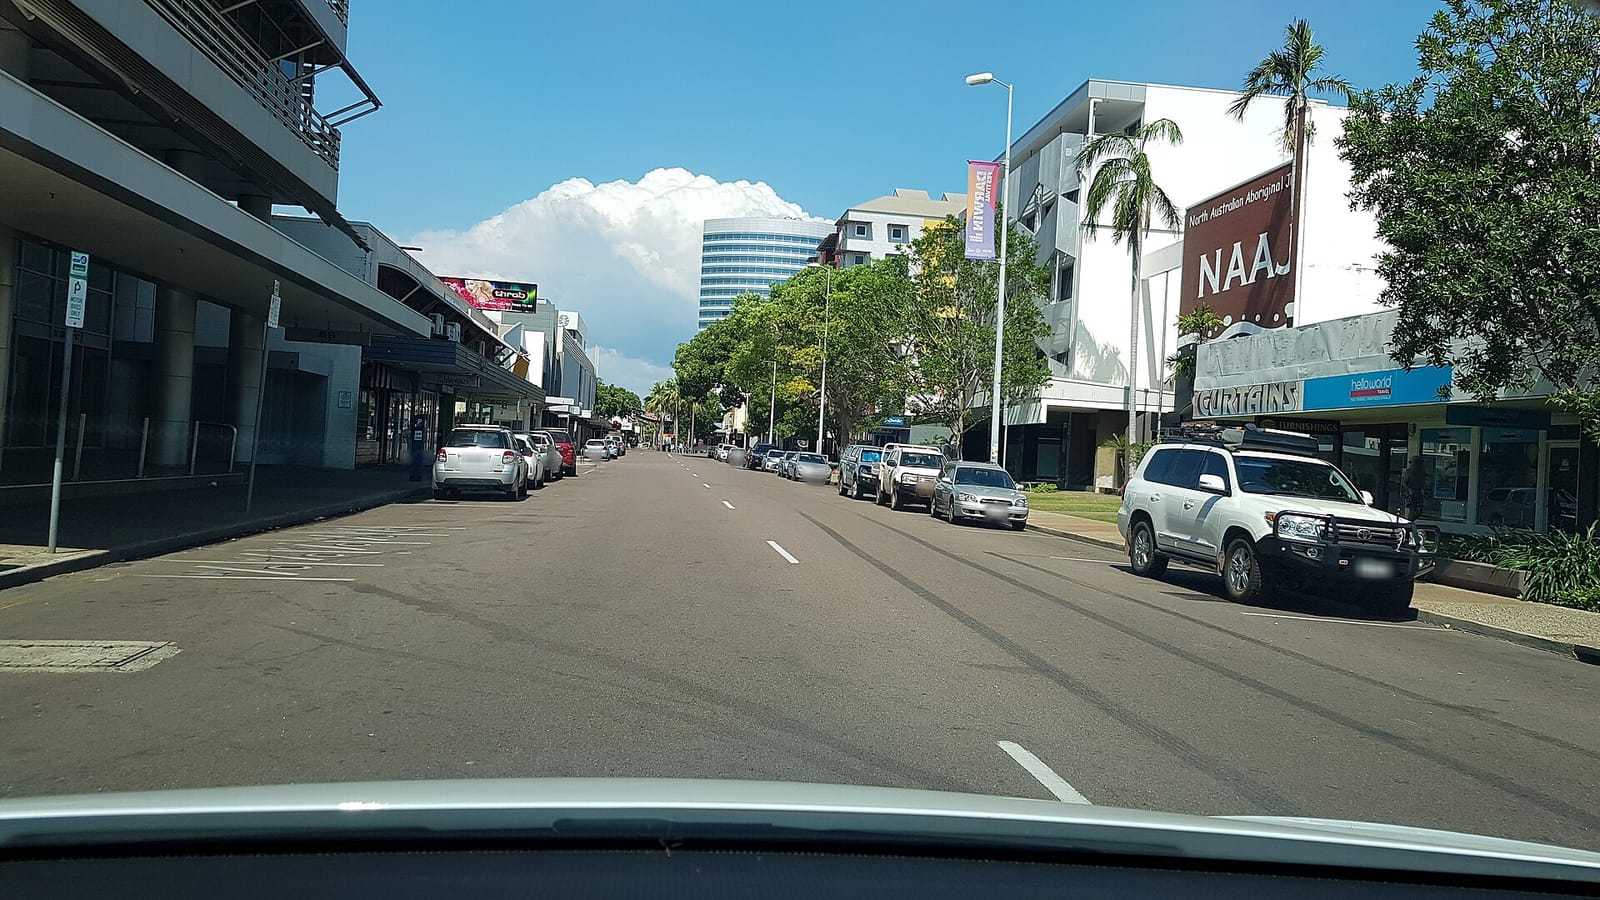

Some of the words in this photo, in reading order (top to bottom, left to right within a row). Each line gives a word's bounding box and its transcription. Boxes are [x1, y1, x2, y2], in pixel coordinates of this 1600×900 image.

[1188, 209, 1209, 228] North
[1209, 196, 1244, 220] Australian
[1244, 176, 1284, 204] Aboriginal
[494, 290, 526, 299] throb
[1351, 375, 1392, 390] helloworld
[1198, 382, 1297, 416] CURTAINS
[1279, 421, 1338, 432] FURNISHINGS
